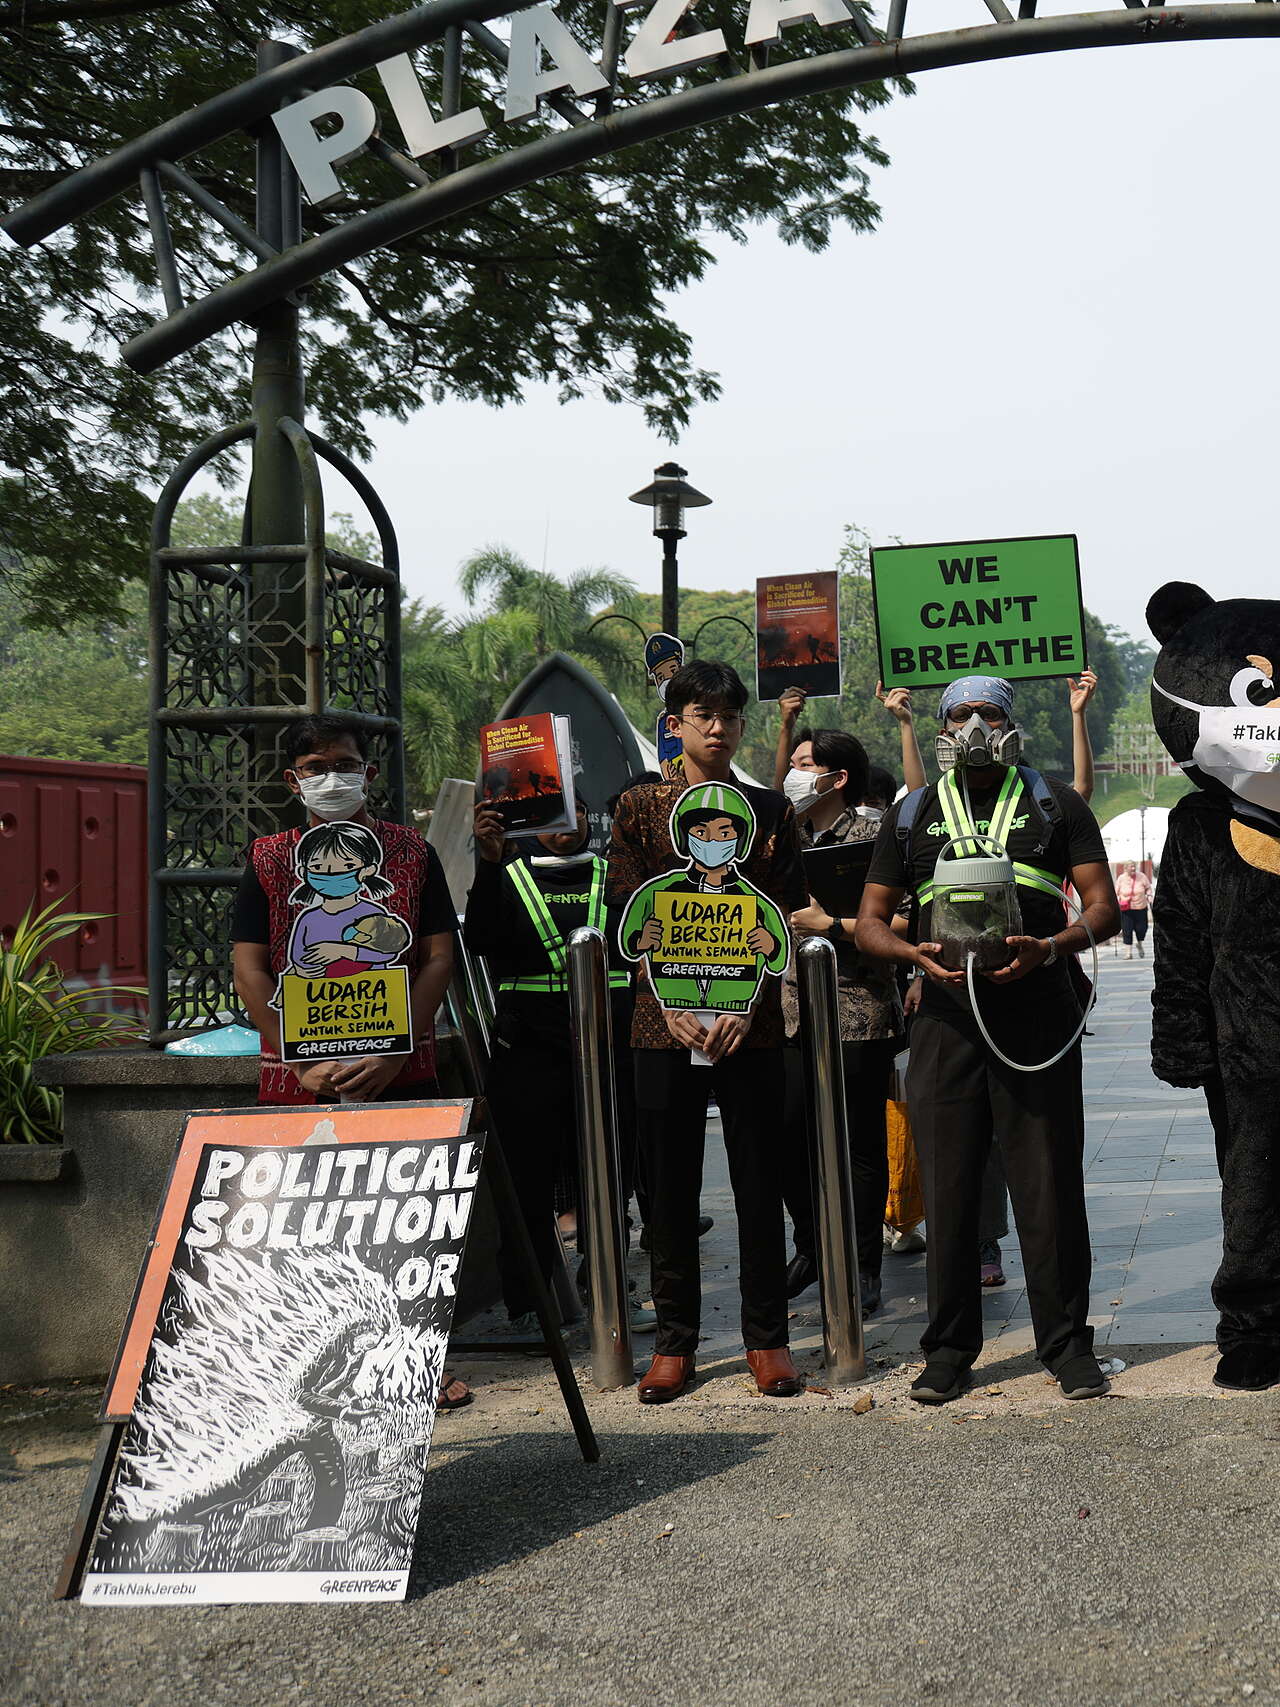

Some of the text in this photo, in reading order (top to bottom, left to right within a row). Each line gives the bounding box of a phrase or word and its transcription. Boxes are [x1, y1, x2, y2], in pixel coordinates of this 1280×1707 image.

[938, 555, 1000, 585] WE
[919, 595, 1038, 630] CAN'T
[890, 635, 1075, 675] BREATHE
[670, 899, 743, 927] UDARA
[661, 946, 748, 958] UNTUK SEMUA
[661, 963, 745, 977] GREENPEACE
[306, 979, 387, 1003] UDARA
[299, 1020, 395, 1037] UNTUK SEMUA
[296, 1036, 397, 1056] GREENPEACE
[201, 1141, 479, 1199] POLITICAL
[184, 1190, 474, 1249] SOLUTION
[393, 1253, 460, 1301] OR
[92, 1578, 402, 1597] #TakNakJerebu GREENPEACE
